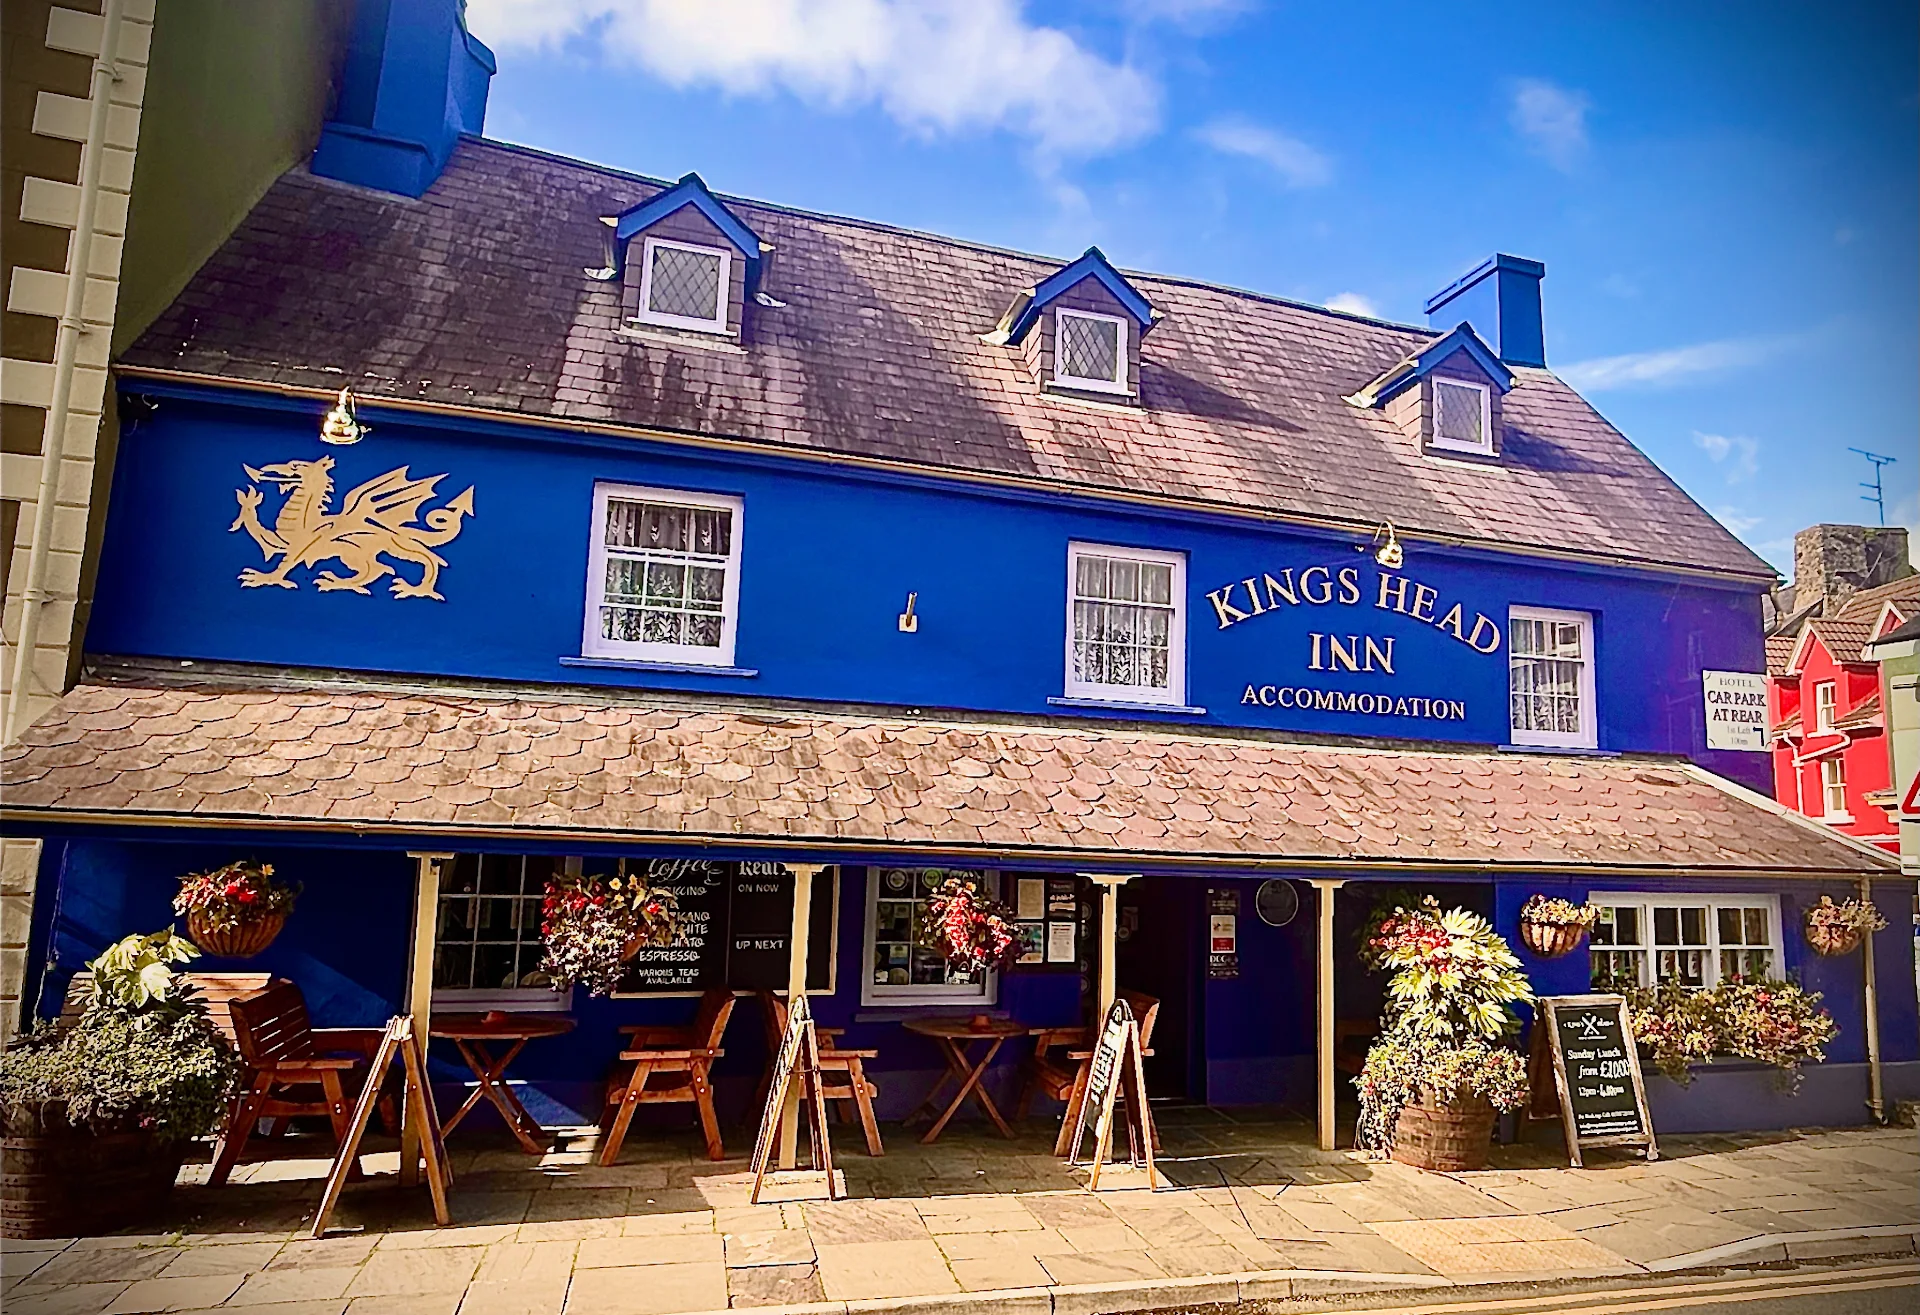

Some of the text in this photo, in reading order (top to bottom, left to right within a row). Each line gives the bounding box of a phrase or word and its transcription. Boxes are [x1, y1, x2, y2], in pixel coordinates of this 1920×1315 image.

[1206, 566, 1500, 654] KINGS HEAD
[1308, 633, 1395, 674] INN
[1719, 677, 1755, 687] HOTEL
[1241, 685, 1465, 720] ACCOMMODATION
[1707, 691, 1766, 707] CAR PARK
[1713, 708, 1763, 723] AT REAR
[1737, 726, 1750, 734] Left
[738, 884, 779, 893] ON NOW
[736, 940, 784, 949] UP NEXT
[639, 950, 700, 961] ESPRESSO
[639, 968, 699, 977] VARIOUS TEAS
[1567, 1047, 1621, 1060] Sunday Lunch
[1578, 1064, 1598, 1079] from
